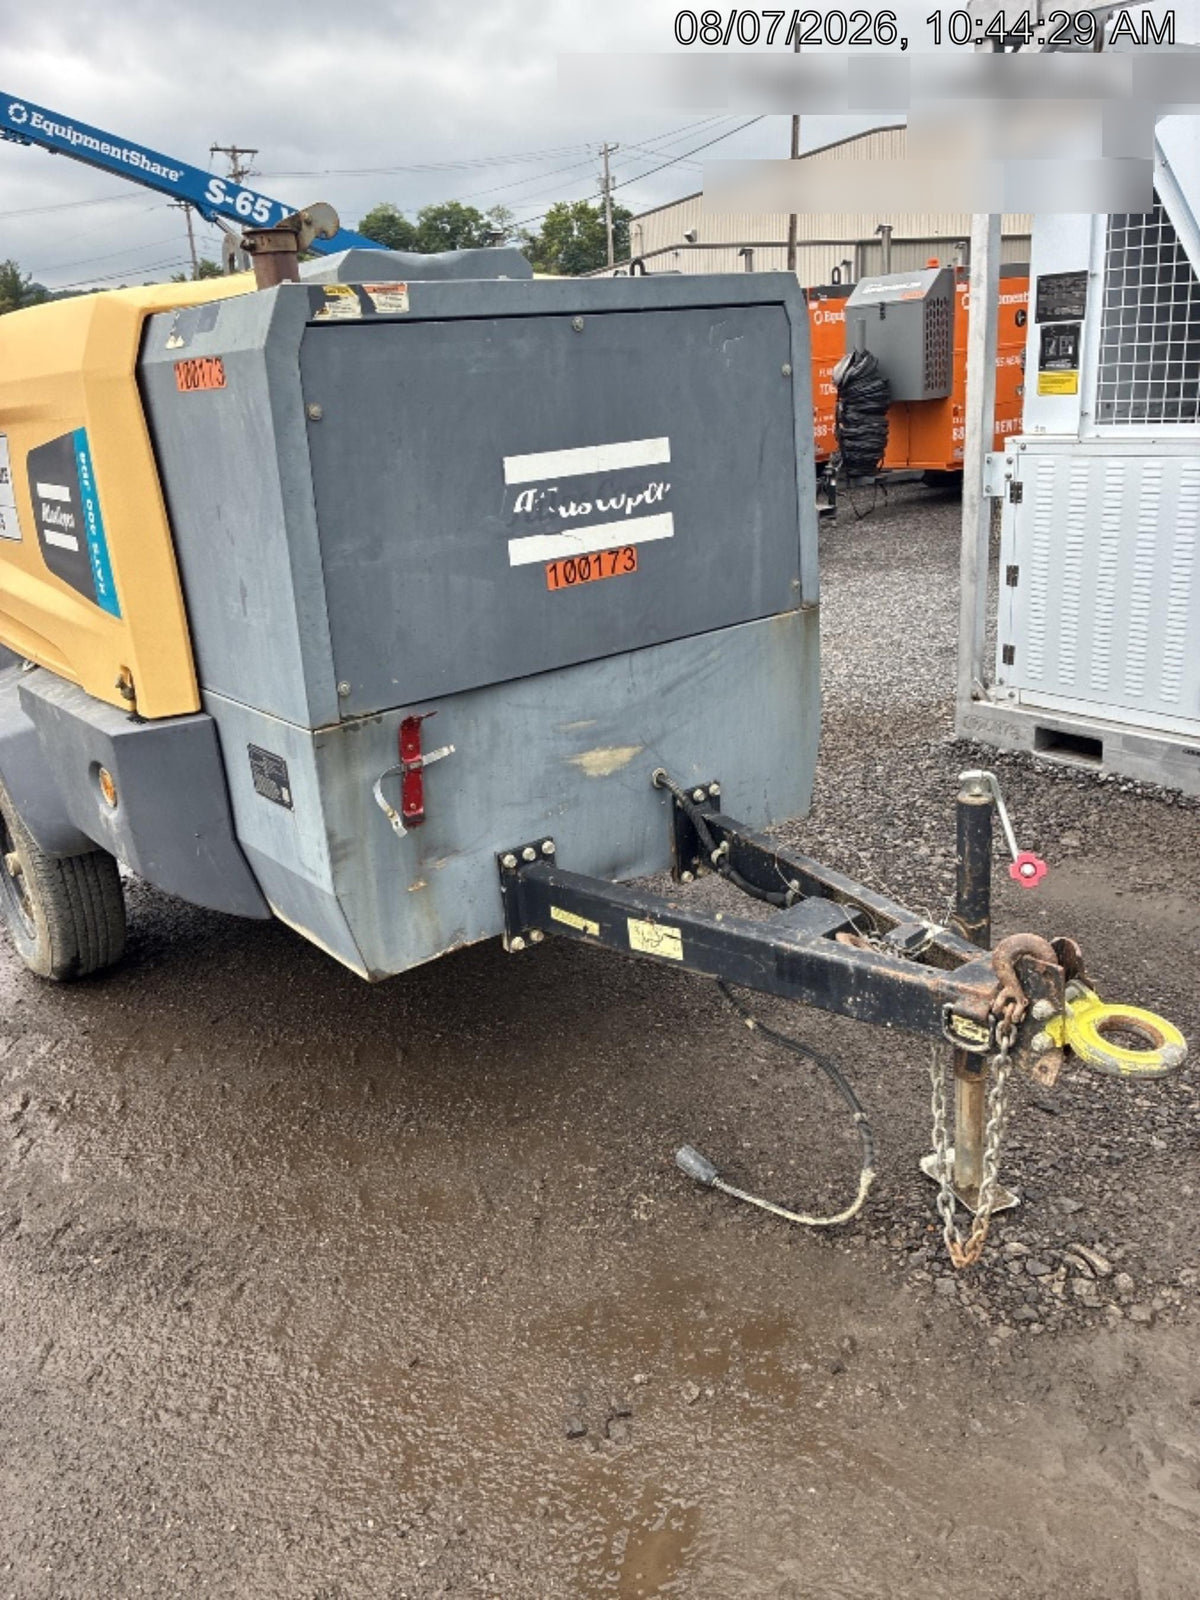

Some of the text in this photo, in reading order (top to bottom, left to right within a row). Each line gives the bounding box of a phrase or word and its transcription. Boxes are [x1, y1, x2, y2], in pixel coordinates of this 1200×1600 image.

[29, 110, 181, 183] EquipmentShare
[204, 178, 273, 224] S-65
[549, 547, 636, 588] 100173
